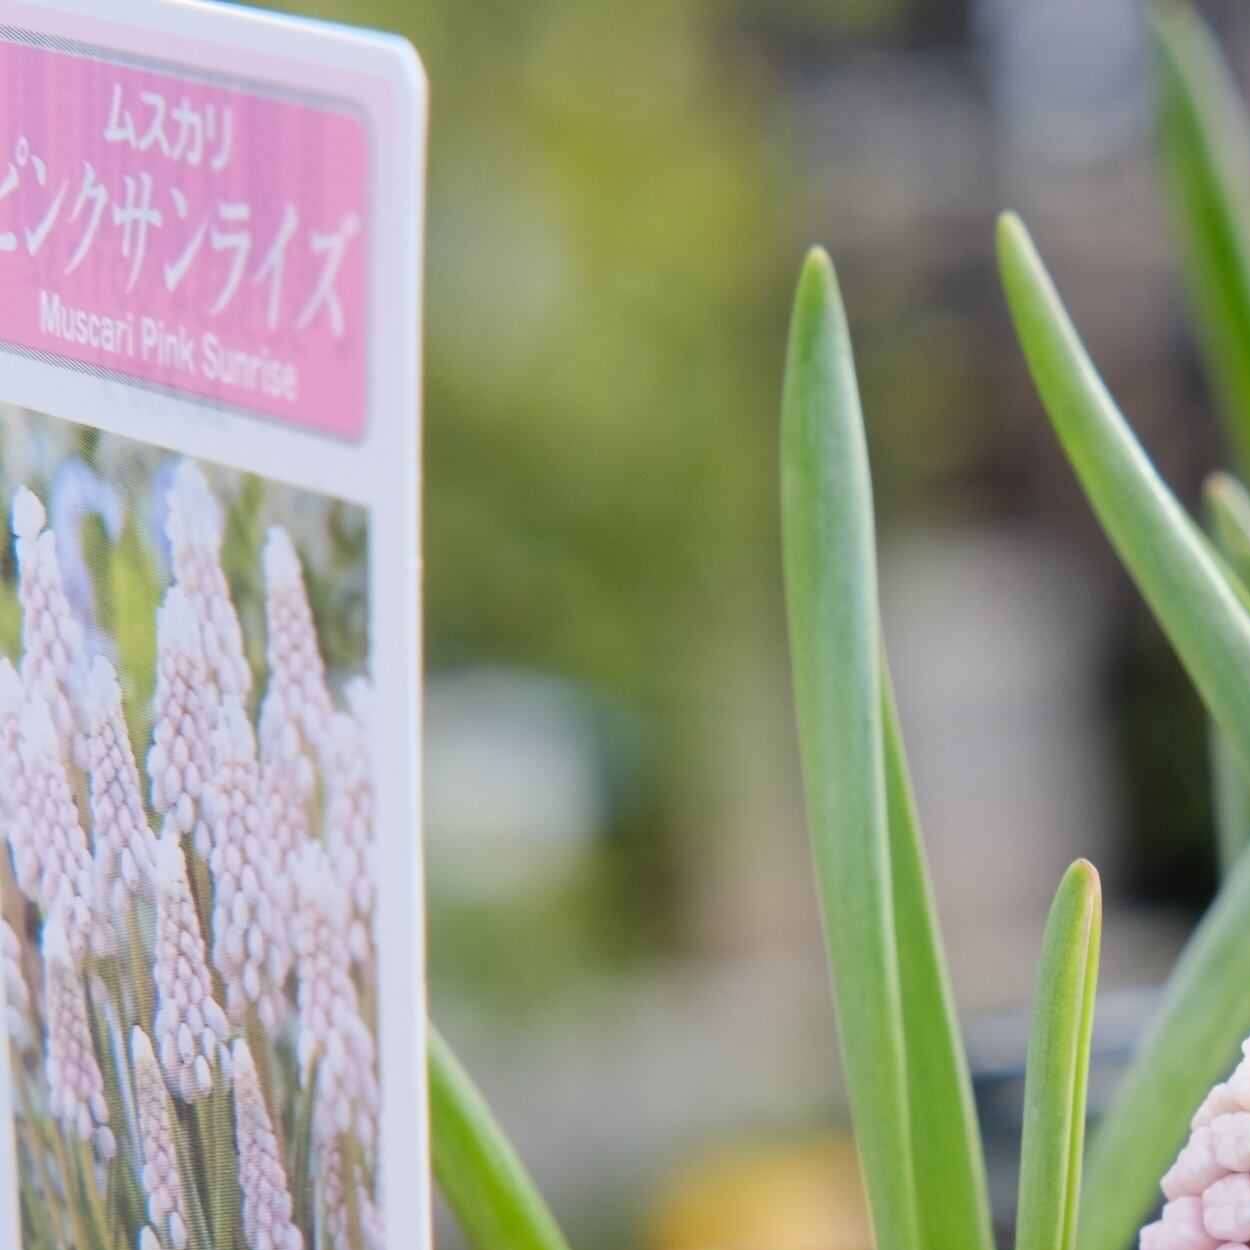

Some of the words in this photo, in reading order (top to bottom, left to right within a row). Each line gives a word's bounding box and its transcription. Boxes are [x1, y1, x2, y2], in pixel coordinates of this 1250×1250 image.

[104, 83, 233, 169] ムスカリ
[39, 289, 134, 356] Muscari
[141, 316, 195, 374] Pink
[202, 334, 297, 401] Sunrise
